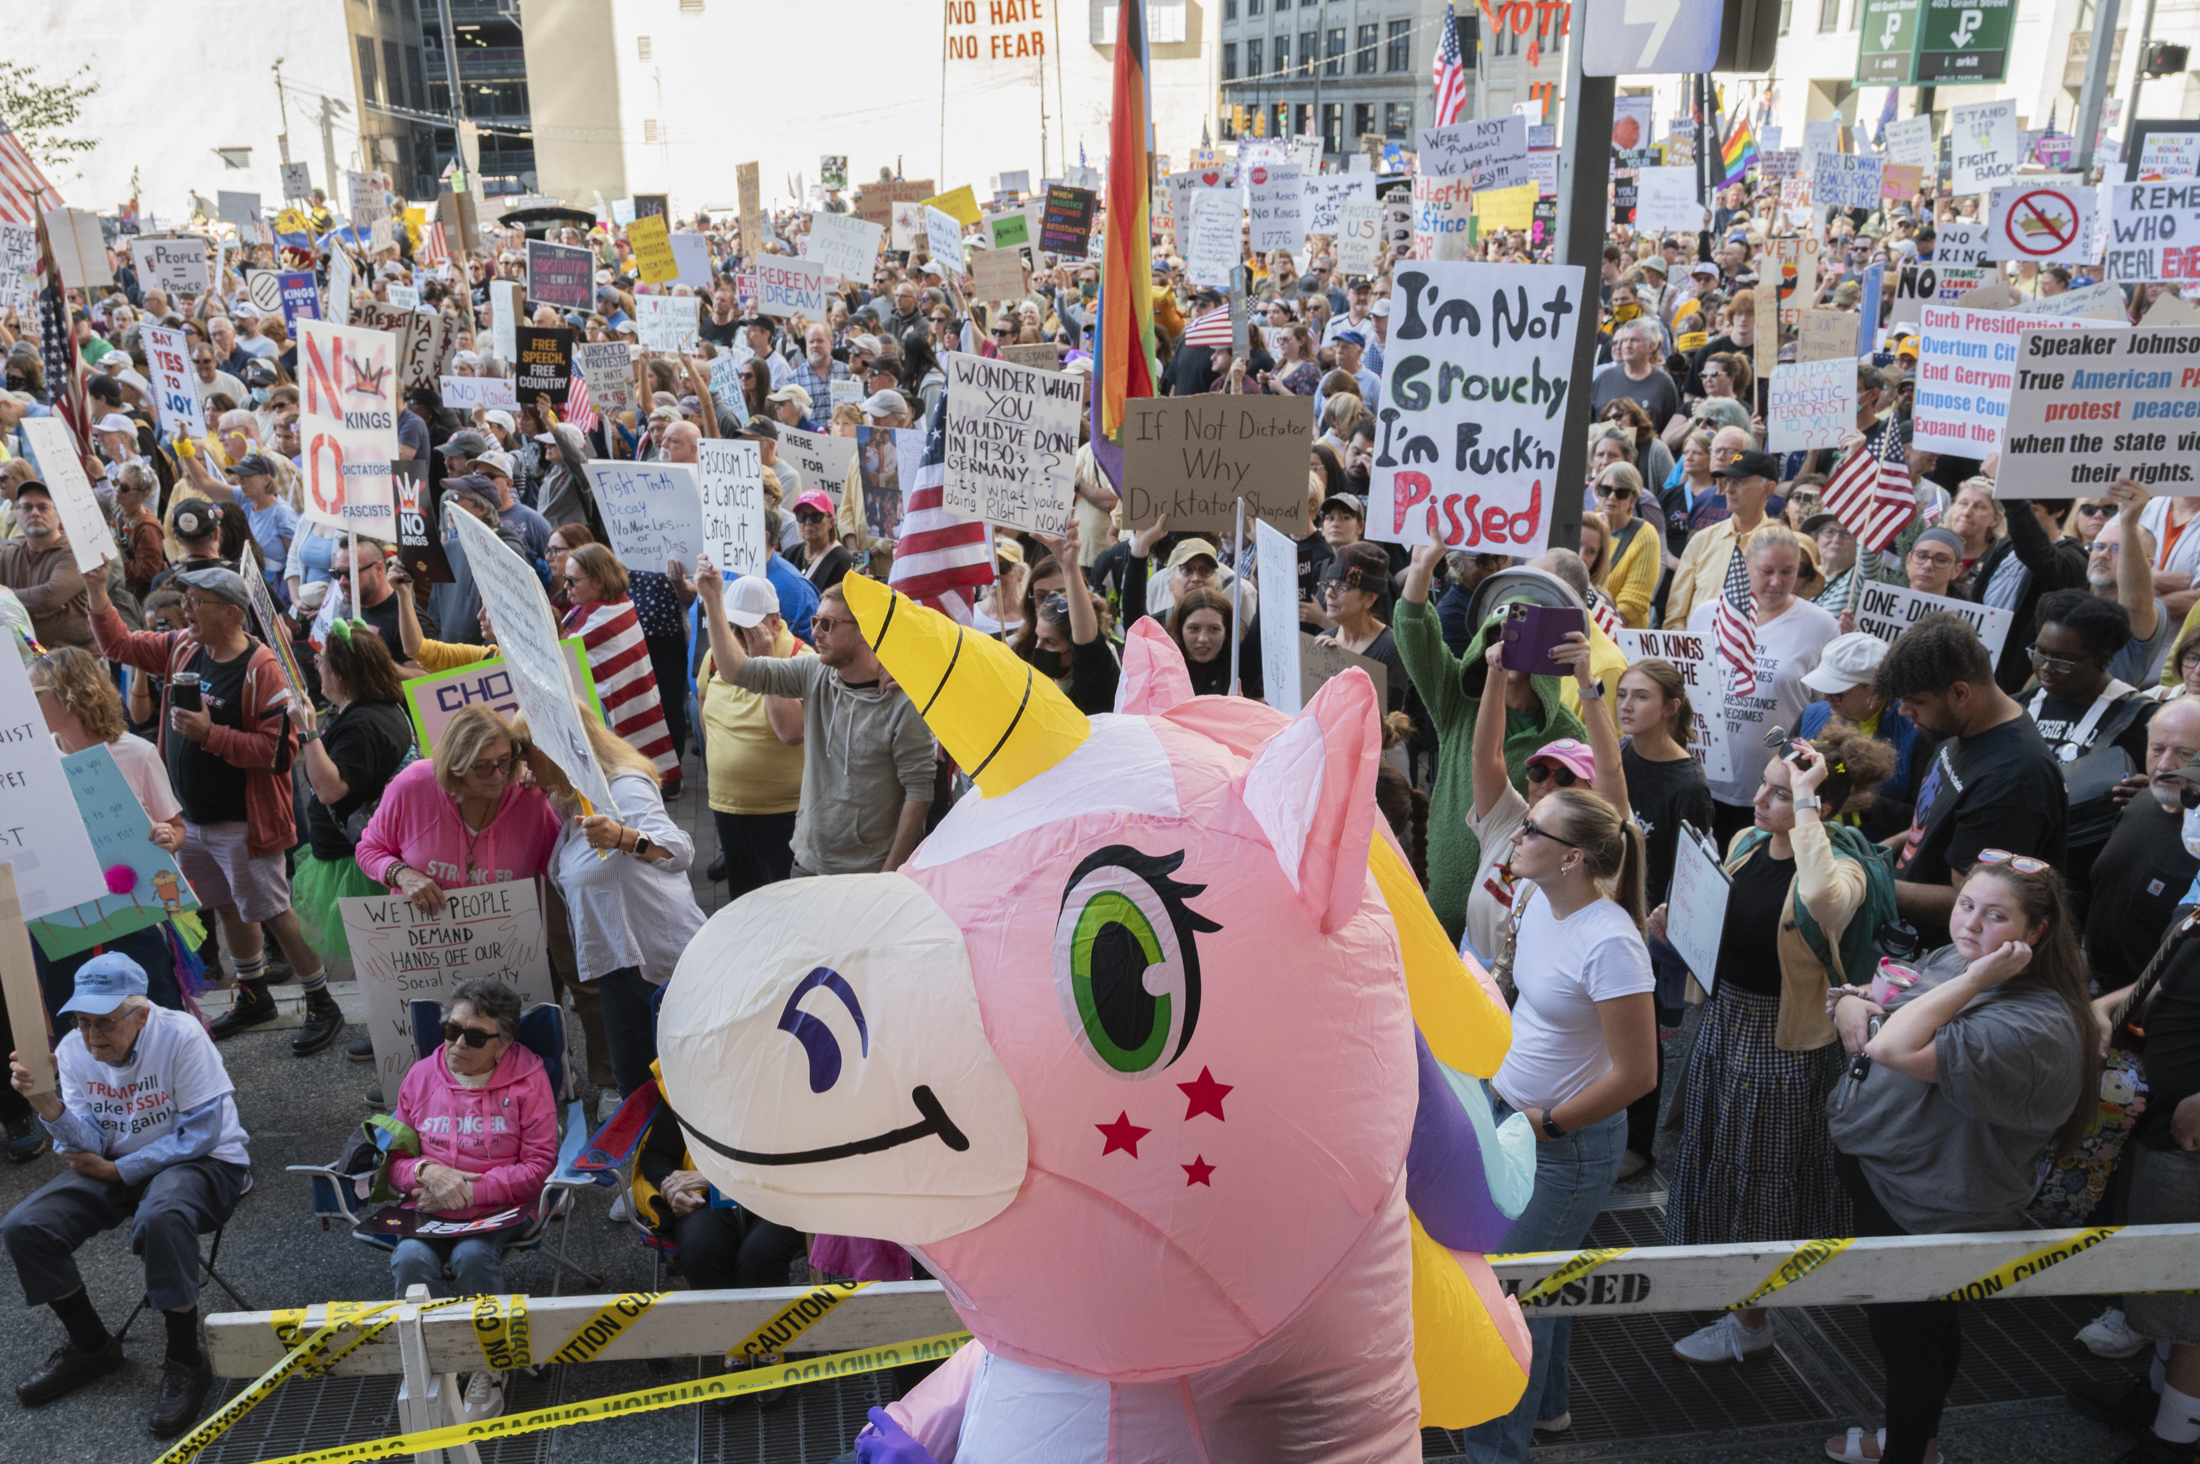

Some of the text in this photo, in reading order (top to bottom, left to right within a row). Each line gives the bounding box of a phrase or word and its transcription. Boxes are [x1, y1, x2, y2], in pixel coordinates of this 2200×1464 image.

[949, 0, 1043, 25] NO HATE
[949, 31, 1045, 59] NO FEAR
[1954, 107, 2008, 123] STAND
[1477, 120, 1508, 137] NOT
[1970, 120, 1995, 137] UP
[1817, 152, 1841, 170] THIS
[1844, 155, 1855, 171] IS
[1857, 156, 1884, 172] WHAT
[1958, 150, 1998, 169] FIGHT
[1812, 170, 1884, 193] DEMOCRACY
[1975, 163, 2015, 182] BACK
[1052, 190, 1074, 199] WHEN
[1386, 194, 1412, 204] SAME
[1850, 191, 1878, 209] LIKE
[2, 226, 34, 248] PEACE
[1261, 230, 1292, 246] 1776
[1347, 220, 1375, 239] US
[1942, 231, 1970, 245] NO
[2113, 214, 2176, 244] WHO
[155, 245, 203, 264] PEOPLE
[820, 238, 864, 260] EPSTEIN
[1344, 243, 1369, 254] FROM
[533, 258, 589, 275] CONSTITUTION
[2107, 248, 2159, 280] REAL
[161, 278, 202, 294] POWER
[289, 277, 305, 289] NO
[758, 265, 822, 292] REDEEM
[1900, 267, 1985, 299] NO THRONES
[1940, 279, 1979, 289] CROWNS
[284, 287, 316, 301] KINGS
[534, 284, 589, 301] SUGGESTION
[765, 283, 823, 312] DREAM
[364, 304, 412, 331] REJECT
[1396, 270, 1574, 349] I'm Not
[1924, 309, 1960, 329] Curb
[151, 331, 173, 348] SAY
[532, 337, 558, 352] FREE
[1922, 336, 1988, 359] Overturn
[2029, 334, 2117, 358] Speaker
[522, 350, 566, 367] SPEECH,
[582, 343, 627, 358] UNPAID
[1024, 351, 1054, 363] STAND
[153, 349, 185, 375] YES
[530, 364, 556, 378] FREE
[585, 354, 632, 370] PROTESTER
[1776, 364, 1797, 379] DO
[1922, 362, 1949, 381] End
[166, 373, 181, 390] TO
[518, 374, 568, 390] COUNTRY
[603, 368, 624, 381] HATE
[956, 361, 1081, 402] WONDER WHAT
[1784, 373, 1834, 392] LIKE A
[2019, 369, 2173, 390] True American
[451, 382, 477, 402] NO
[1391, 354, 1568, 421] Grouchy
[1771, 385, 1844, 407] DOMESTIC
[164, 391, 194, 417] JOY
[985, 391, 1033, 421] YOU
[1770, 397, 1850, 420] TERRORIST
[1915, 388, 1972, 411] Impose
[345, 411, 393, 430] KINGS
[2044, 401, 2122, 423] protest
[1136, 408, 1307, 441] If Not Dictator
[1783, 414, 1838, 432] TO YOU
[1914, 416, 1996, 443] Expand the
[786, 433, 814, 450] HERE
[949, 413, 1078, 456] WOULD'VE DONE
[1374, 407, 1556, 475] I'm Fuck'n
[2010, 432, 2167, 454] when the state
[949, 433, 1026, 465] IN 1930's
[342, 463, 393, 477] DICTATORS
[700, 443, 740, 479] Fascism
[802, 458, 824, 474] FOR
[1182, 447, 1250, 493] Why
[2070, 462, 2195, 485] their rights.
[596, 471, 675, 499] Fight Truth
[703, 485, 711, 505] a
[819, 478, 843, 494] THE
[986, 484, 1027, 505] what
[342, 504, 392, 519] FASCISTS
[606, 500, 647, 518] Decay
[946, 490, 1068, 533] doing RIGHT NOW
[1130, 487, 1300, 522] Dicktator Shaped
[1393, 470, 1542, 548] Pissed
[400, 513, 425, 537] NO
[612, 519, 632, 537] No
[704, 513, 749, 541] Catch it
[401, 534, 429, 548] KINGS
[637, 533, 651, 542] or
[663, 535, 688, 554] Dies
[722, 542, 759, 574] Early.
[1862, 588, 1899, 618] ONE
[1639, 633, 1705, 661] NO KINGS
[1724, 693, 1778, 711] RESISTANCE
[364, 889, 512, 924] WE PEOPLE
[408, 927, 474, 947] DEMAND
[391, 942, 503, 971] HANDS OFF OUR
[397, 970, 443, 991] Social
[1500, 1272, 1652, 1309] LOSED
[742, 1286, 837, 1355] CAUTION
